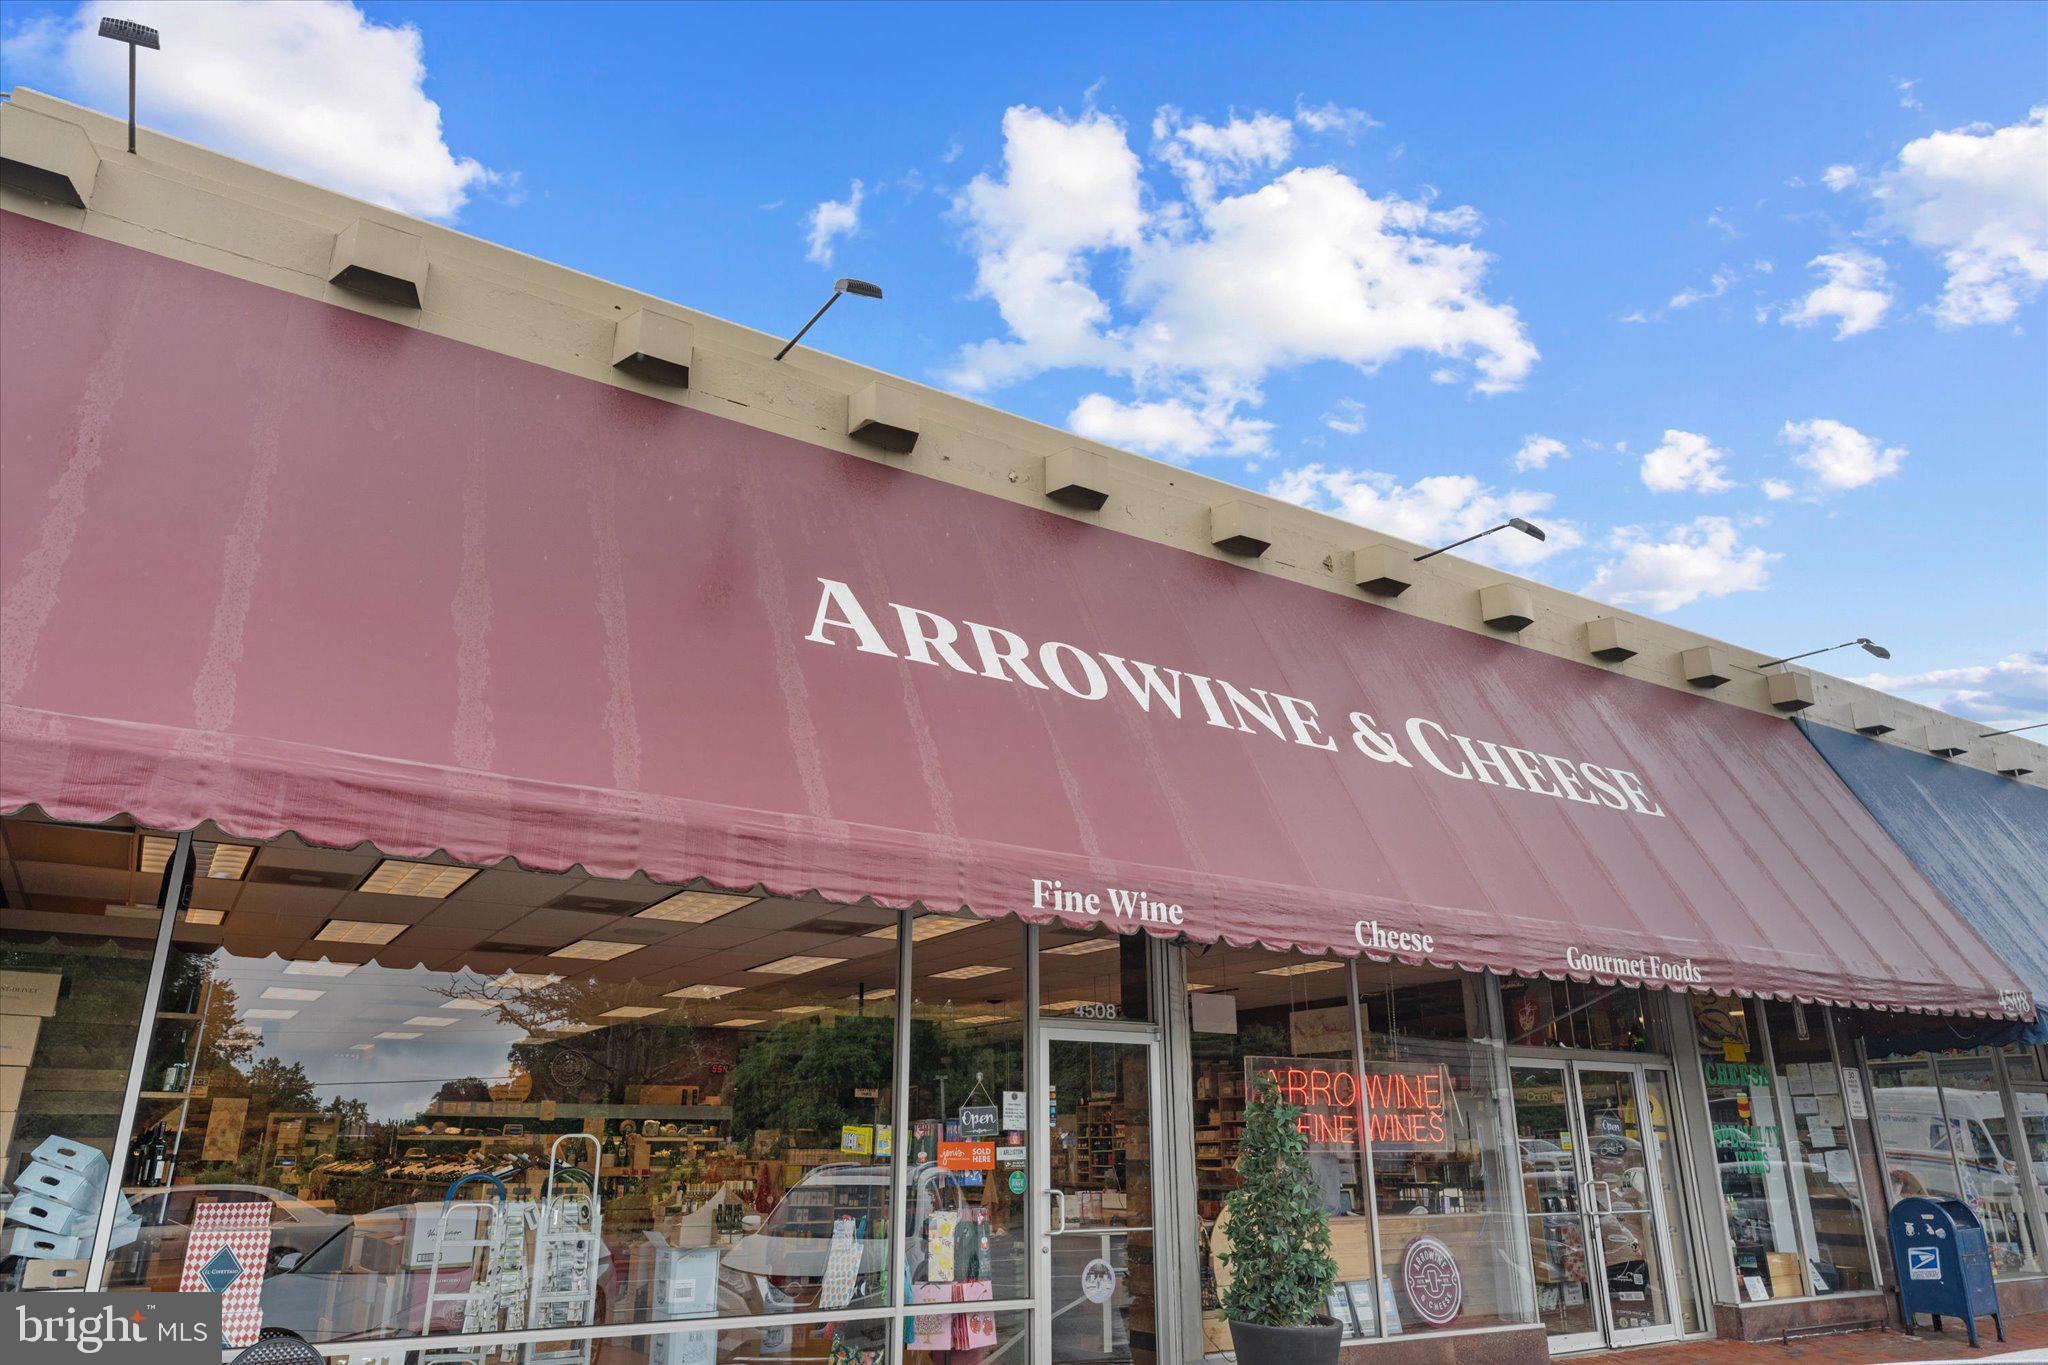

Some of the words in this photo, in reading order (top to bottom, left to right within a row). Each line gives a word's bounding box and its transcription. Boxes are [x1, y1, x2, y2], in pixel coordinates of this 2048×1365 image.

[805, 577, 1339, 752] ARROWINE
[1349, 711, 1413, 768] &
[1405, 717, 1666, 817] CHEESE
[1032, 879, 1100, 915] Fine
[1107, 888, 1184, 925] Wine
[1355, 920, 1434, 953] Cheese
[1567, 946, 1646, 977] Gourmet
[1648, 956, 1702, 983] Foods
[1074, 1003, 1117, 1019] 4508
[1705, 1063, 1773, 1087] CHEESE
[961, 1110, 996, 1129] Open
[1297, 1113, 1355, 1143] FINE
[1369, 1113, 1444, 1142] WINES
[1602, 1119, 1621, 1133] Open
[1712, 1124, 1781, 1149] SPECIALTY
[972, 1155, 991, 1163] HERE
[1413, 1250, 1448, 1271] ARROWINE
[1428, 1292, 1452, 1310] CHEESE
